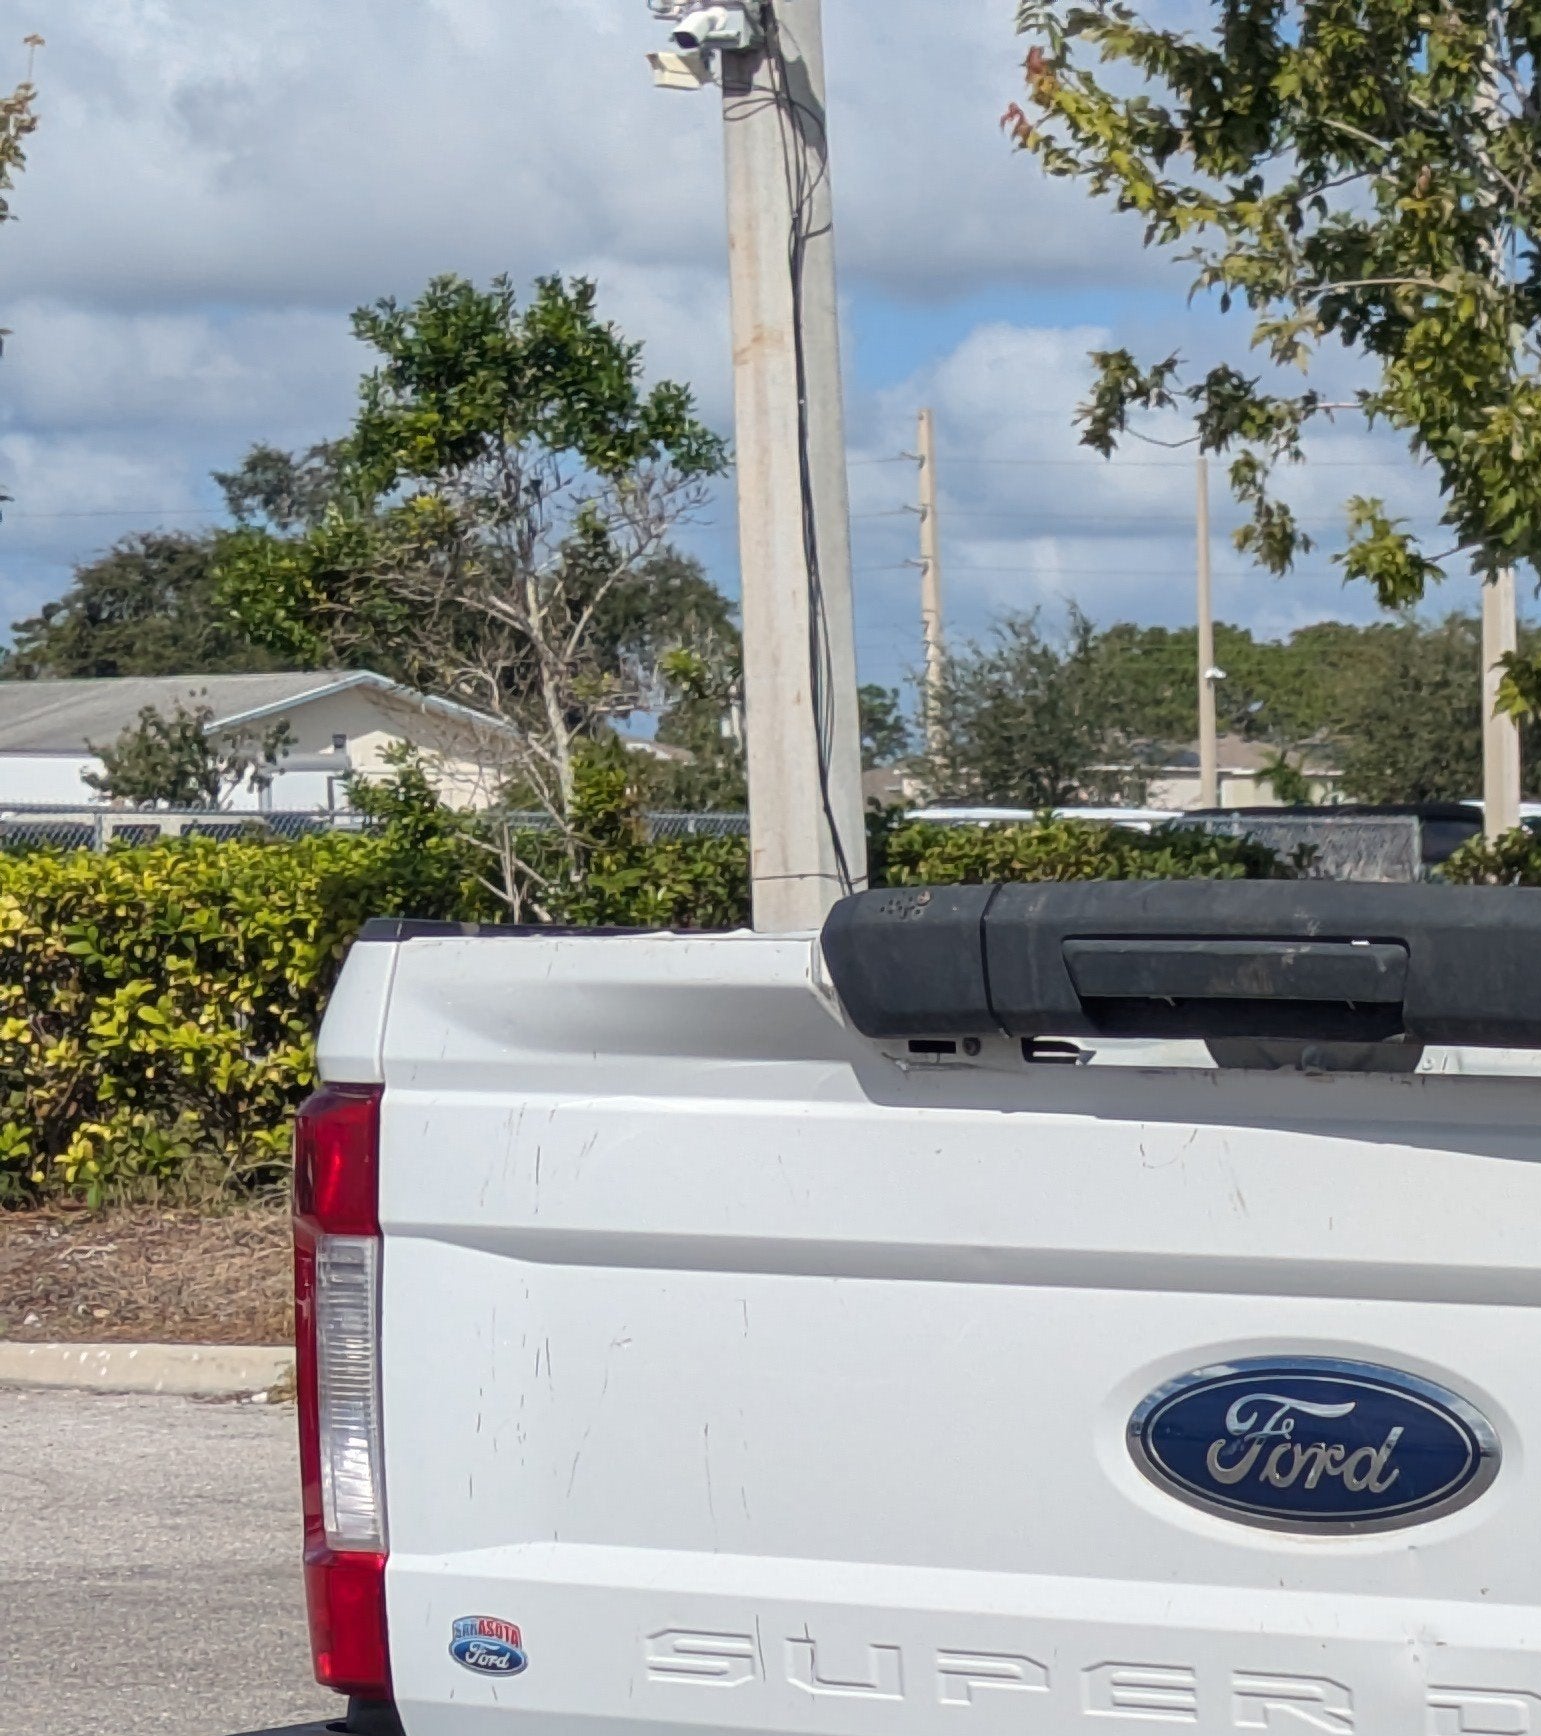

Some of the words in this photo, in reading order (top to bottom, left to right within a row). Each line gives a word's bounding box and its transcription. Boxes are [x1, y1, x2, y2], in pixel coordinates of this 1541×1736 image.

[1206, 1393, 1404, 1493] Ford
[455, 1620, 519, 1648] SARASOTA
[465, 1641, 511, 1669] Ford
[646, 1628, 1355, 1736] SUPER
